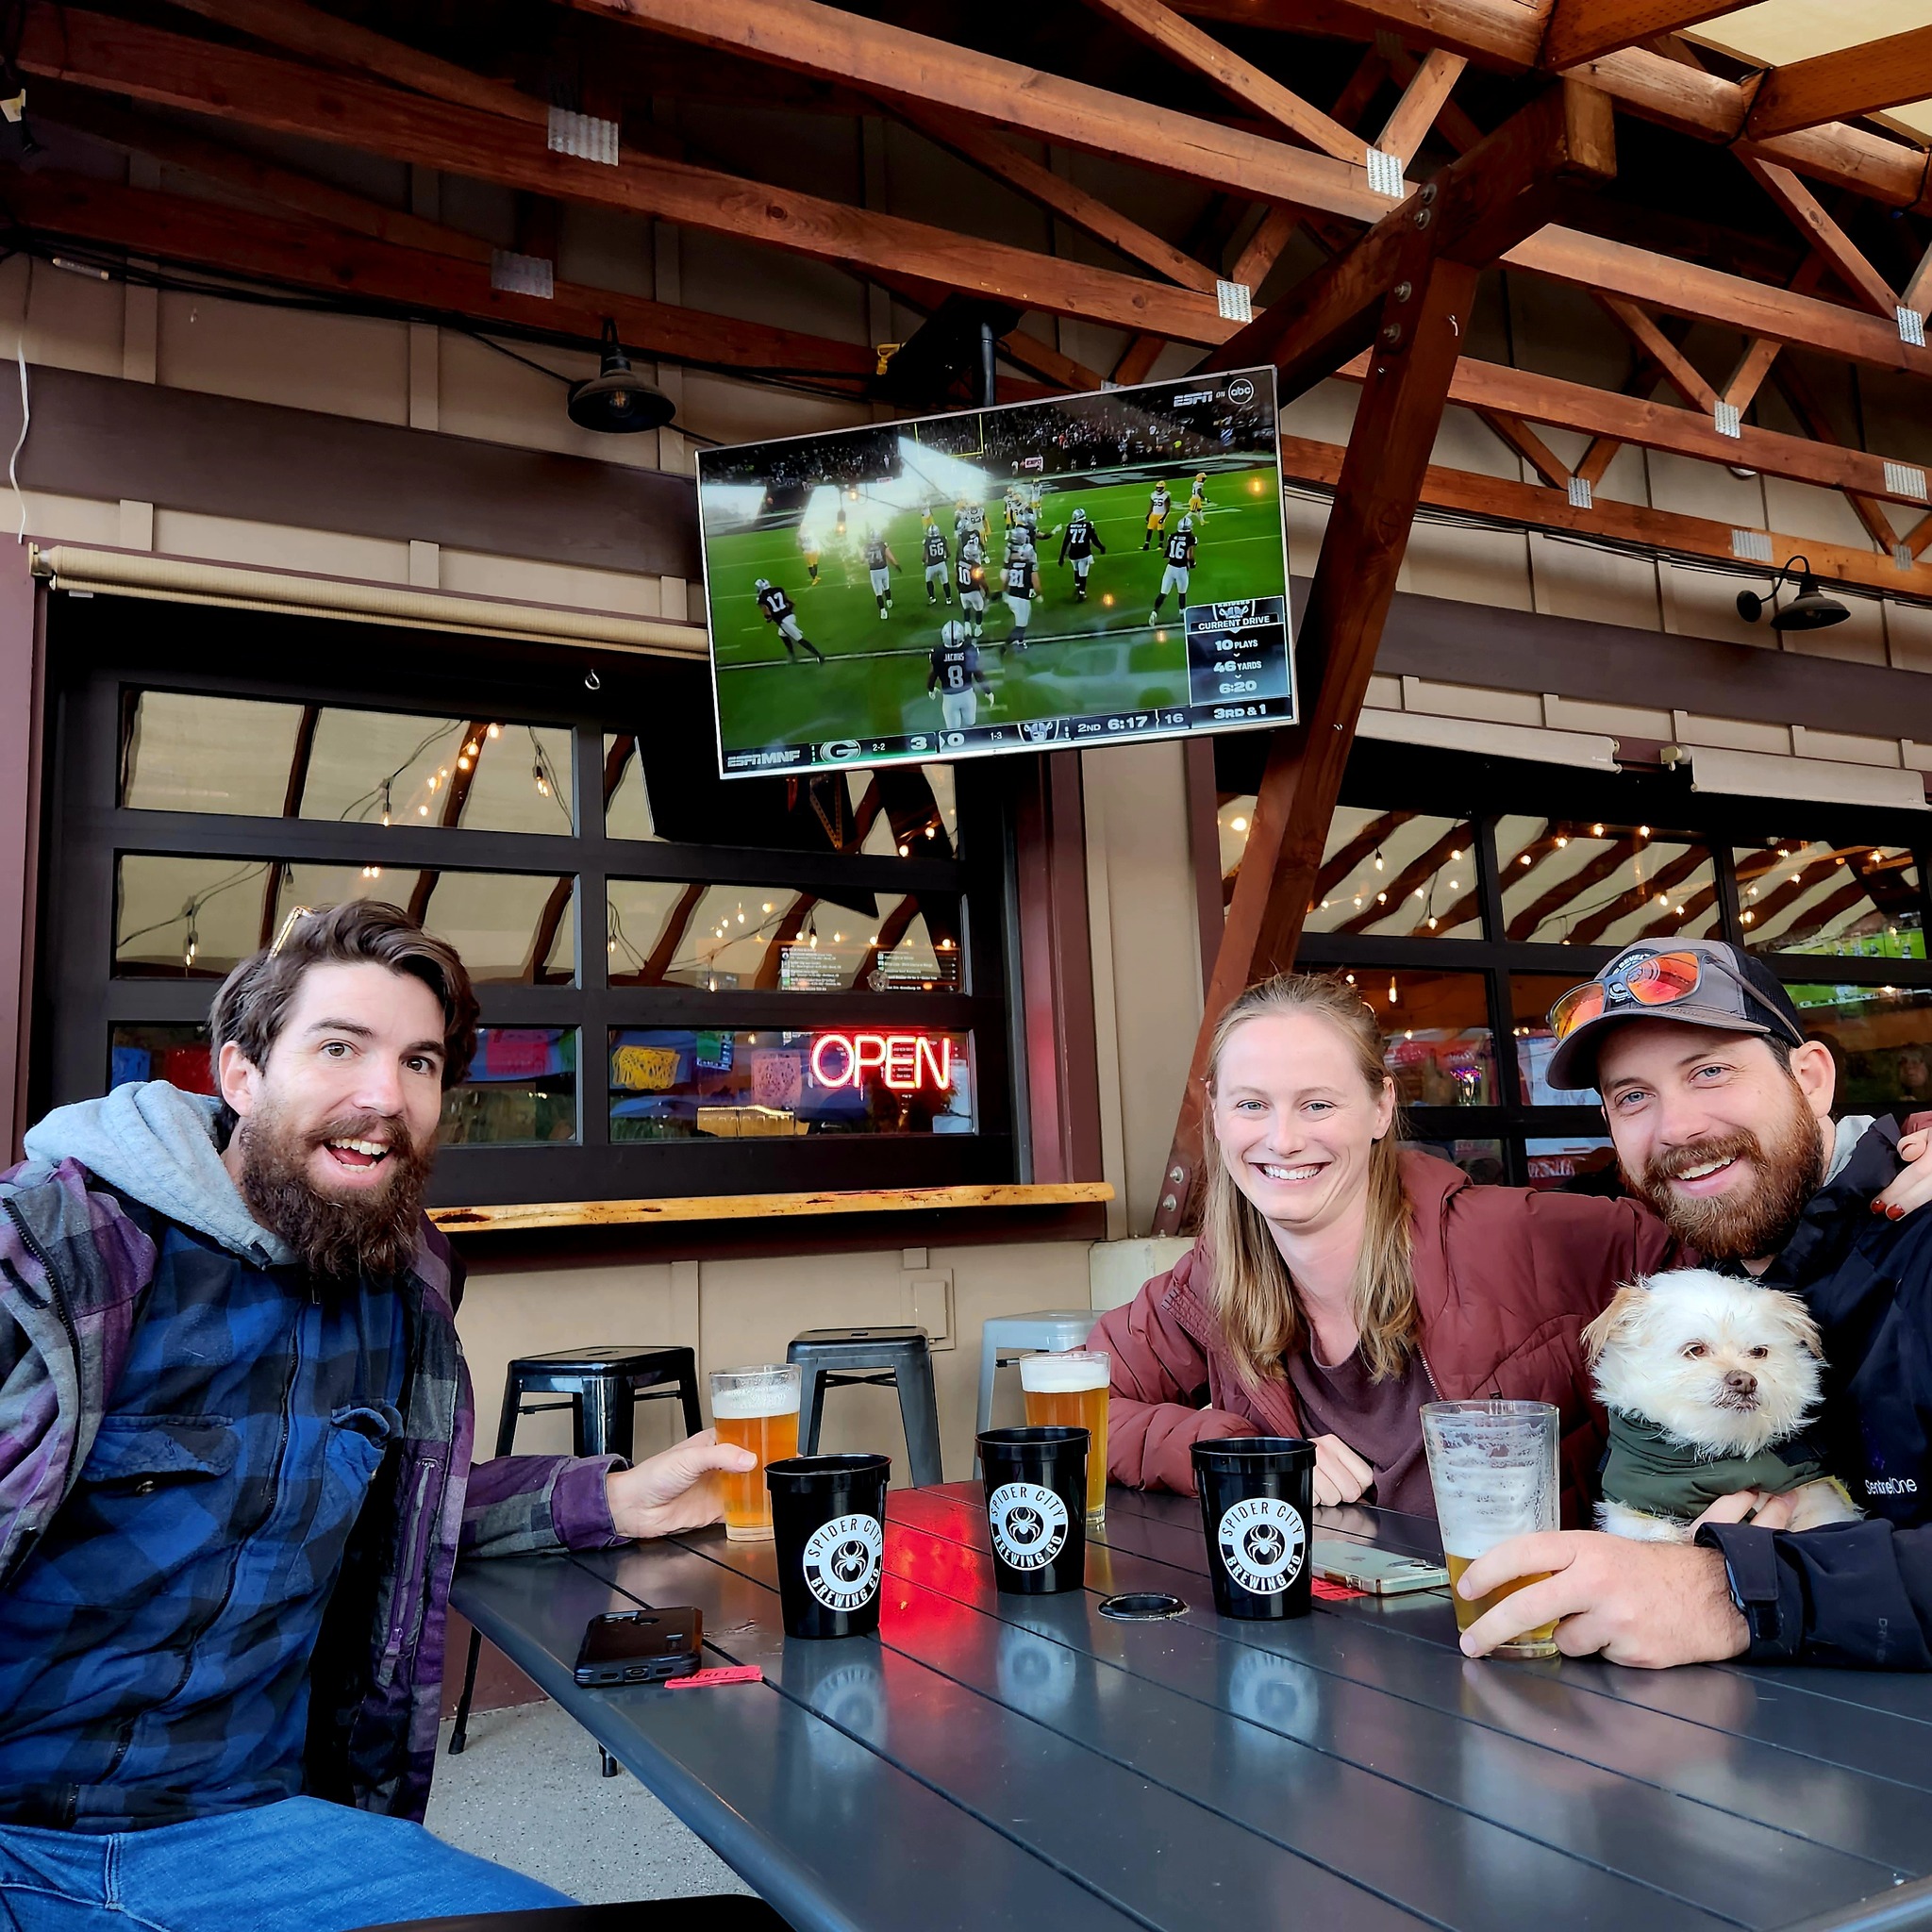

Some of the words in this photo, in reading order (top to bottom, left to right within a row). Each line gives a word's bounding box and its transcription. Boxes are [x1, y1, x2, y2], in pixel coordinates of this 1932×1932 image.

[1174, 391, 1213, 408] ESPN
[1216, 391, 1225, 399] ON
[1230, 386, 1252, 397] abc
[1070, 528, 1086, 543] 77
[929, 542, 944, 558] 66
[1169, 540, 1186, 559] 16
[958, 566, 972, 585] 10
[1008, 569, 1024, 588] 81
[766, 591, 787, 613] 17
[1198, 619, 1241, 630] CURRENT
[1242, 615, 1270, 625] DRIVE
[1214, 640, 1234, 651] 10
[1234, 640, 1258, 649] PLAYS
[948, 664, 964, 688] 8
[1213, 660, 1237, 673] 46
[1237, 660, 1262, 671] YARDS
[1219, 680, 1257, 693] 6:20
[1213, 708, 1244, 720] 3RD
[1246, 707, 1257, 715] &
[1259, 704, 1267, 714] 1
[1077, 724, 1102, 733] 2ND
[1108, 716, 1148, 730] 6:17
[1164, 713, 1184, 724] 16
[910, 736, 927, 751] 3
[947, 733, 965, 747] 0
[991, 732, 1002, 741] 1-3
[821, 740, 860, 763] G
[873, 743, 886, 752] 2-2
[810, 1033, 951, 1090] OPEN
[1865, 1476, 1917, 1495] SentinelOne
[991, 1486, 1027, 1517] SPIDER
[1035, 1490, 1065, 1517] CITY
[1222, 1502, 1269, 1537] SPIDER
[1276, 1505, 1303, 1535] CITY
[808, 1518, 858, 1557] SPIDER
[863, 1520, 882, 1547] CITY
[994, 1535, 1045, 1567] BREWING
[1045, 1535, 1062, 1554] CO
[1226, 1557, 1287, 1591] BREWING
[1287, 1555, 1301, 1575] CO
[811, 1576, 868, 1607] BREWING
[868, 1568, 879, 1589] CO
